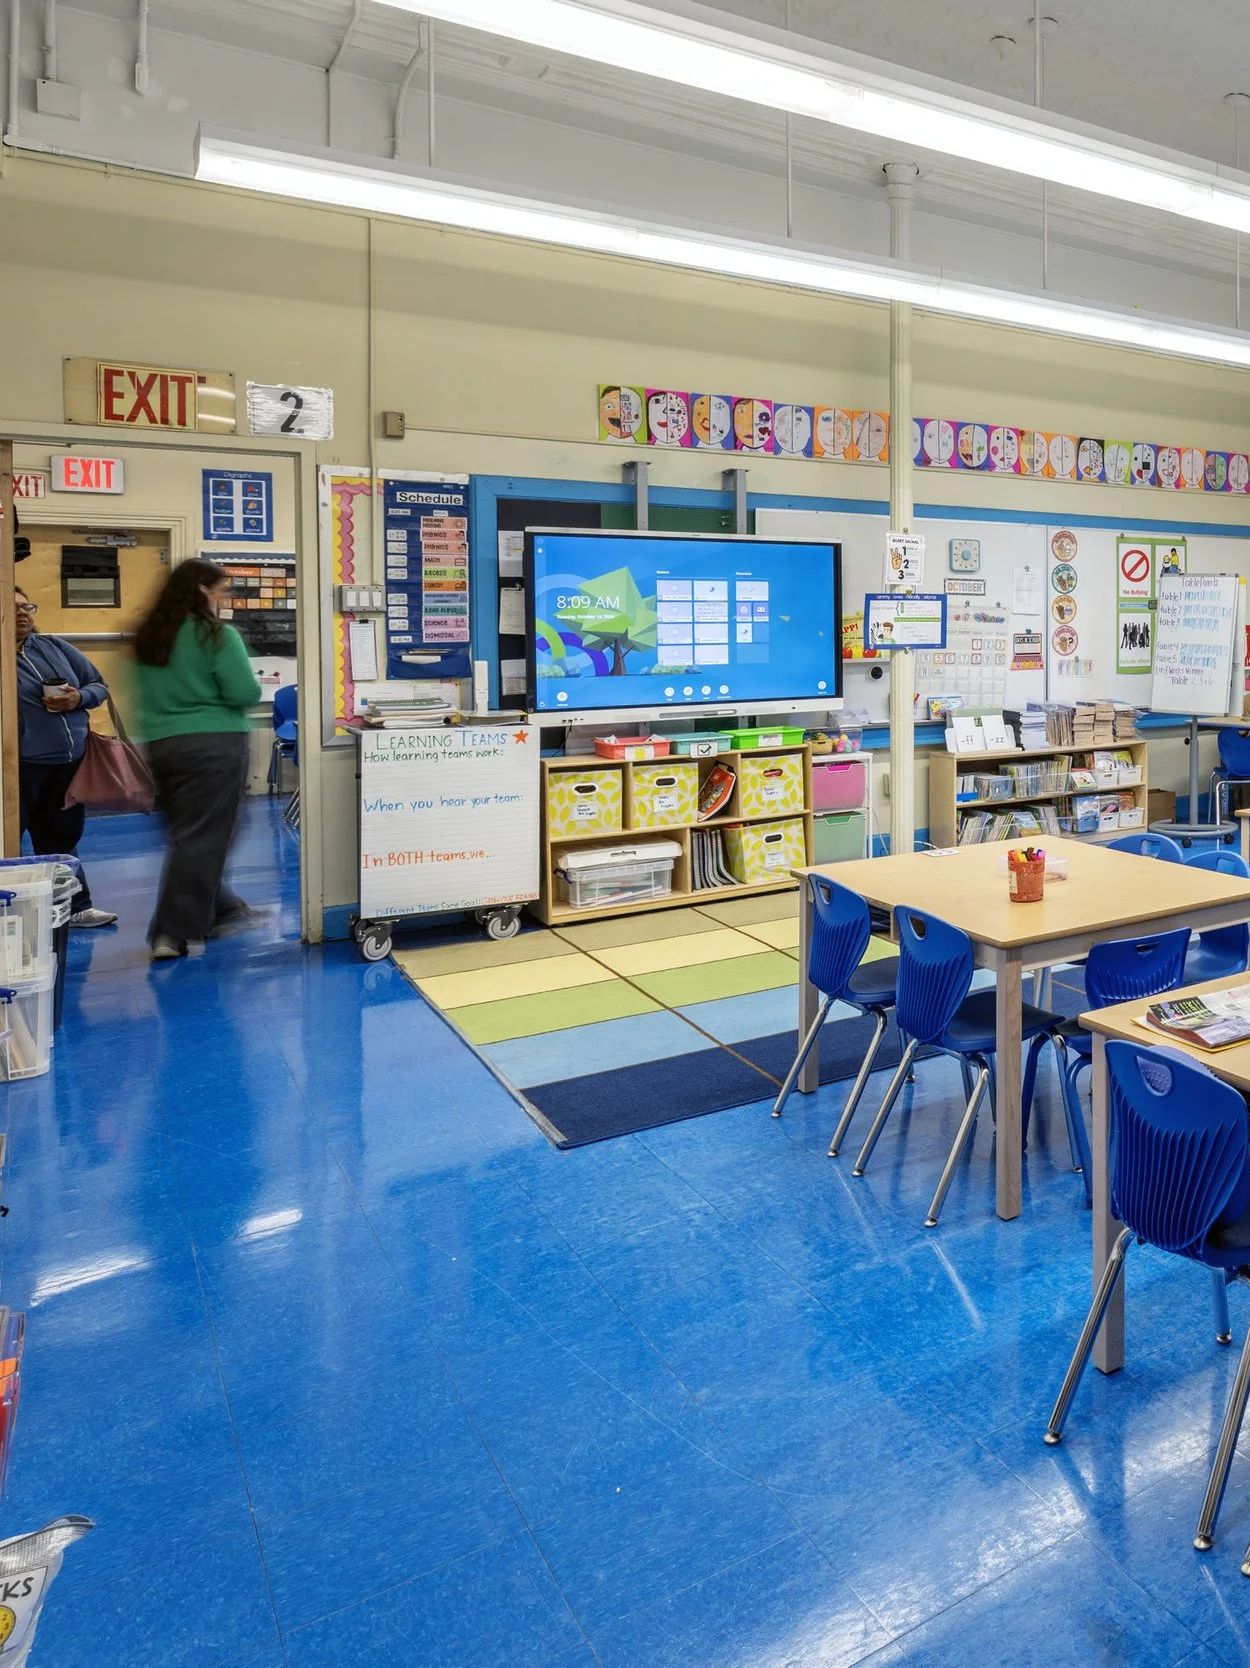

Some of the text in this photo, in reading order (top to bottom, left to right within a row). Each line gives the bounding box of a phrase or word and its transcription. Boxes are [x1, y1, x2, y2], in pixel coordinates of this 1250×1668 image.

[104, 368, 194, 427] EXIT
[280, 391, 305, 433] 2
[63, 457, 116, 489] EXIT
[399, 492, 461, 505] Schedule
[902, 546, 907, 556] 1
[903, 559, 909, 569] 2
[898, 570, 905, 580] 3
[947, 582, 982, 592] OCTOBER
[556, 595, 620, 609] 8:09 AM
[376, 730, 508, 751] LEARNING TEAMS
[364, 751, 389, 763] How
[393, 750, 439, 763] learning
[441, 749, 473, 760] teams
[364, 798, 404, 812] When
[410, 800, 433, 812] you
[440, 795, 466, 807] hear
[471, 796, 491, 808] your
[362, 853, 383, 869] In
[388, 851, 424, 866] BOTH
[0, 1576, 35, 1602] KS
